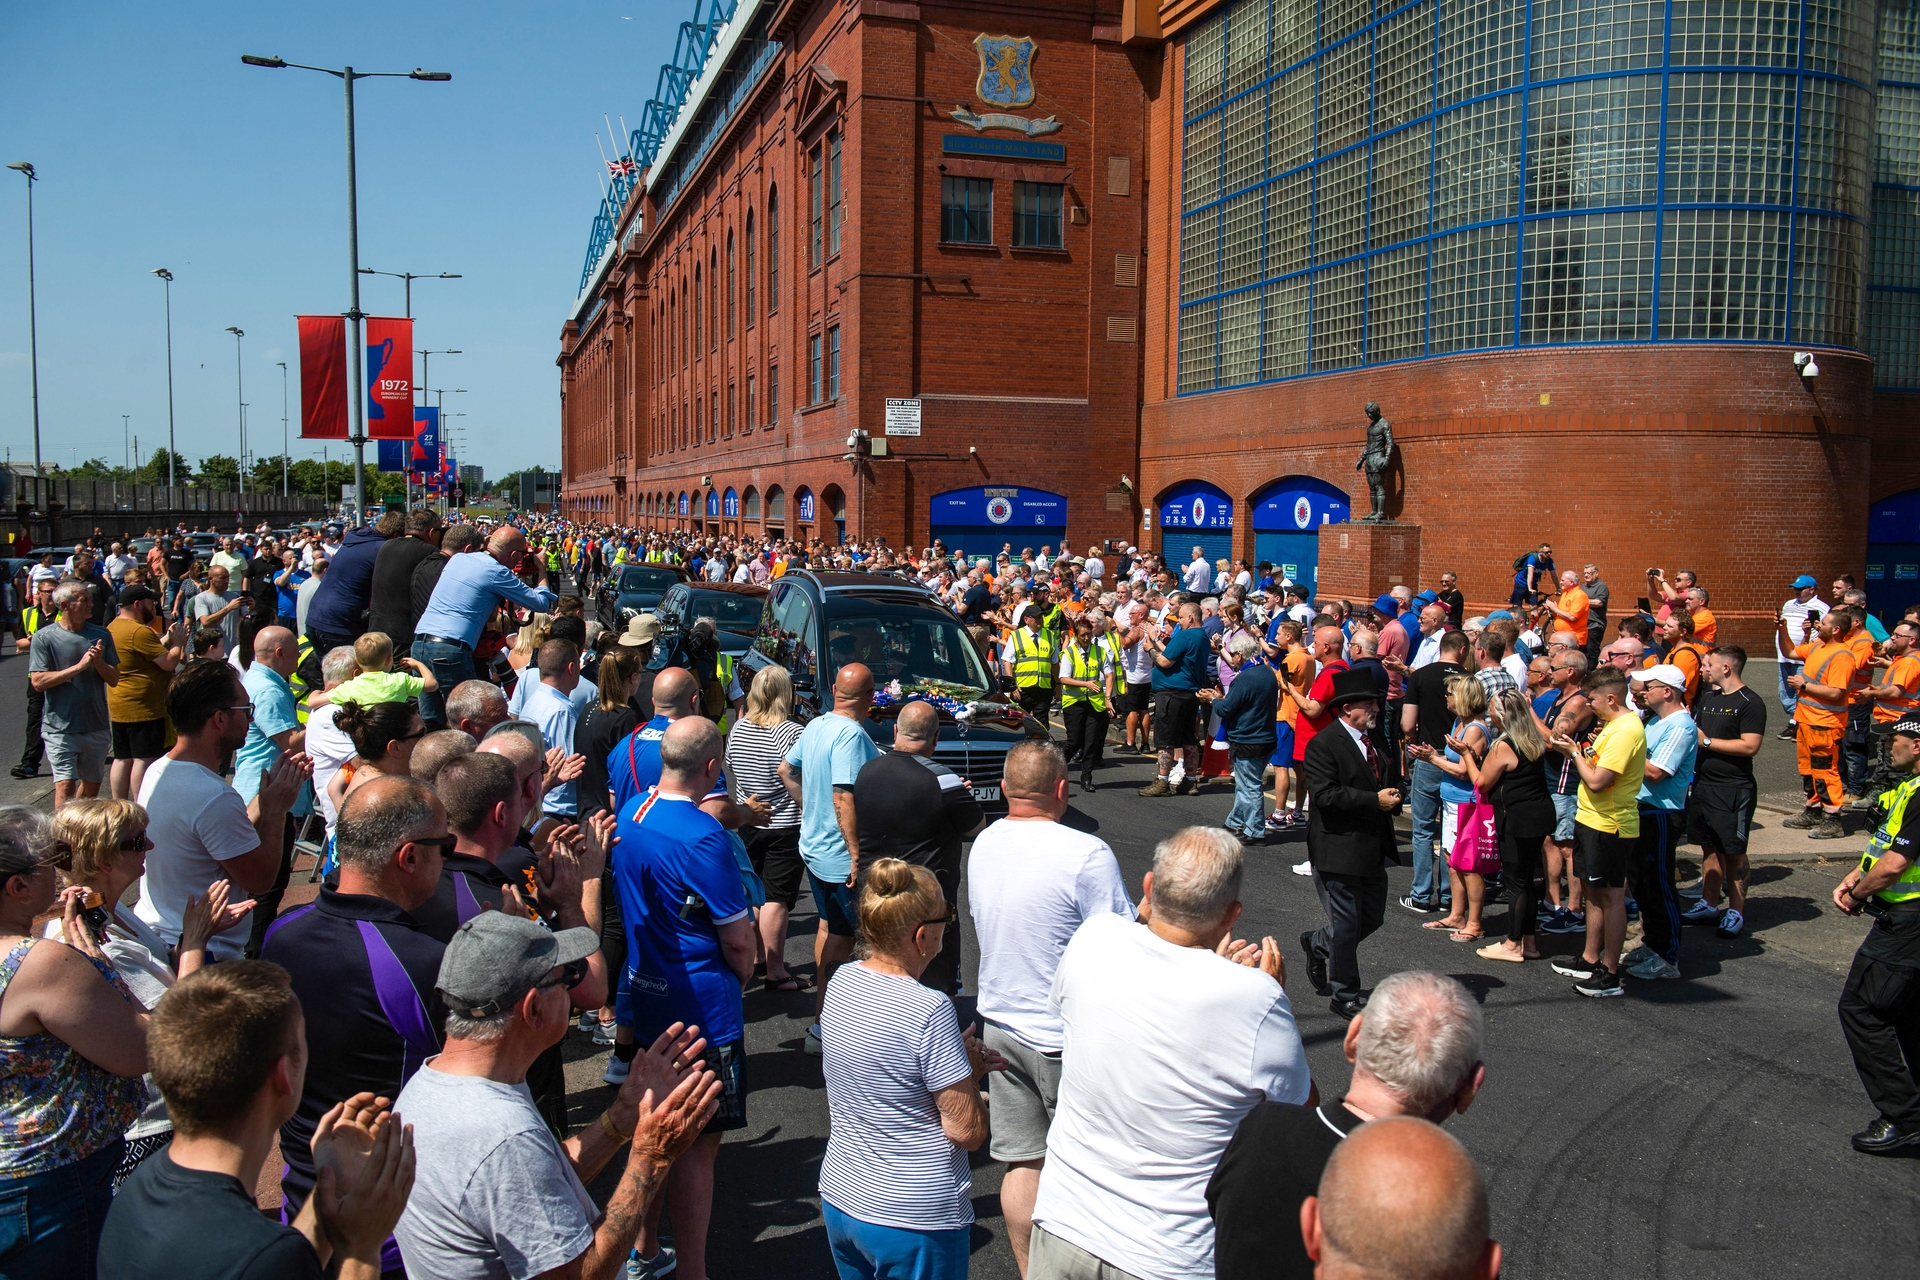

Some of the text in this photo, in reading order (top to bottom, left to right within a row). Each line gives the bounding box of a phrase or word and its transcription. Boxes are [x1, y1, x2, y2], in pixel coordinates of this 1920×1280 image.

[948, 139, 1060, 156] BILL STRUTH MAIN STAND
[380, 379, 408, 391] 1972
[1181, 516, 1187, 524] 25
[974, 788, 996, 800] PJY
